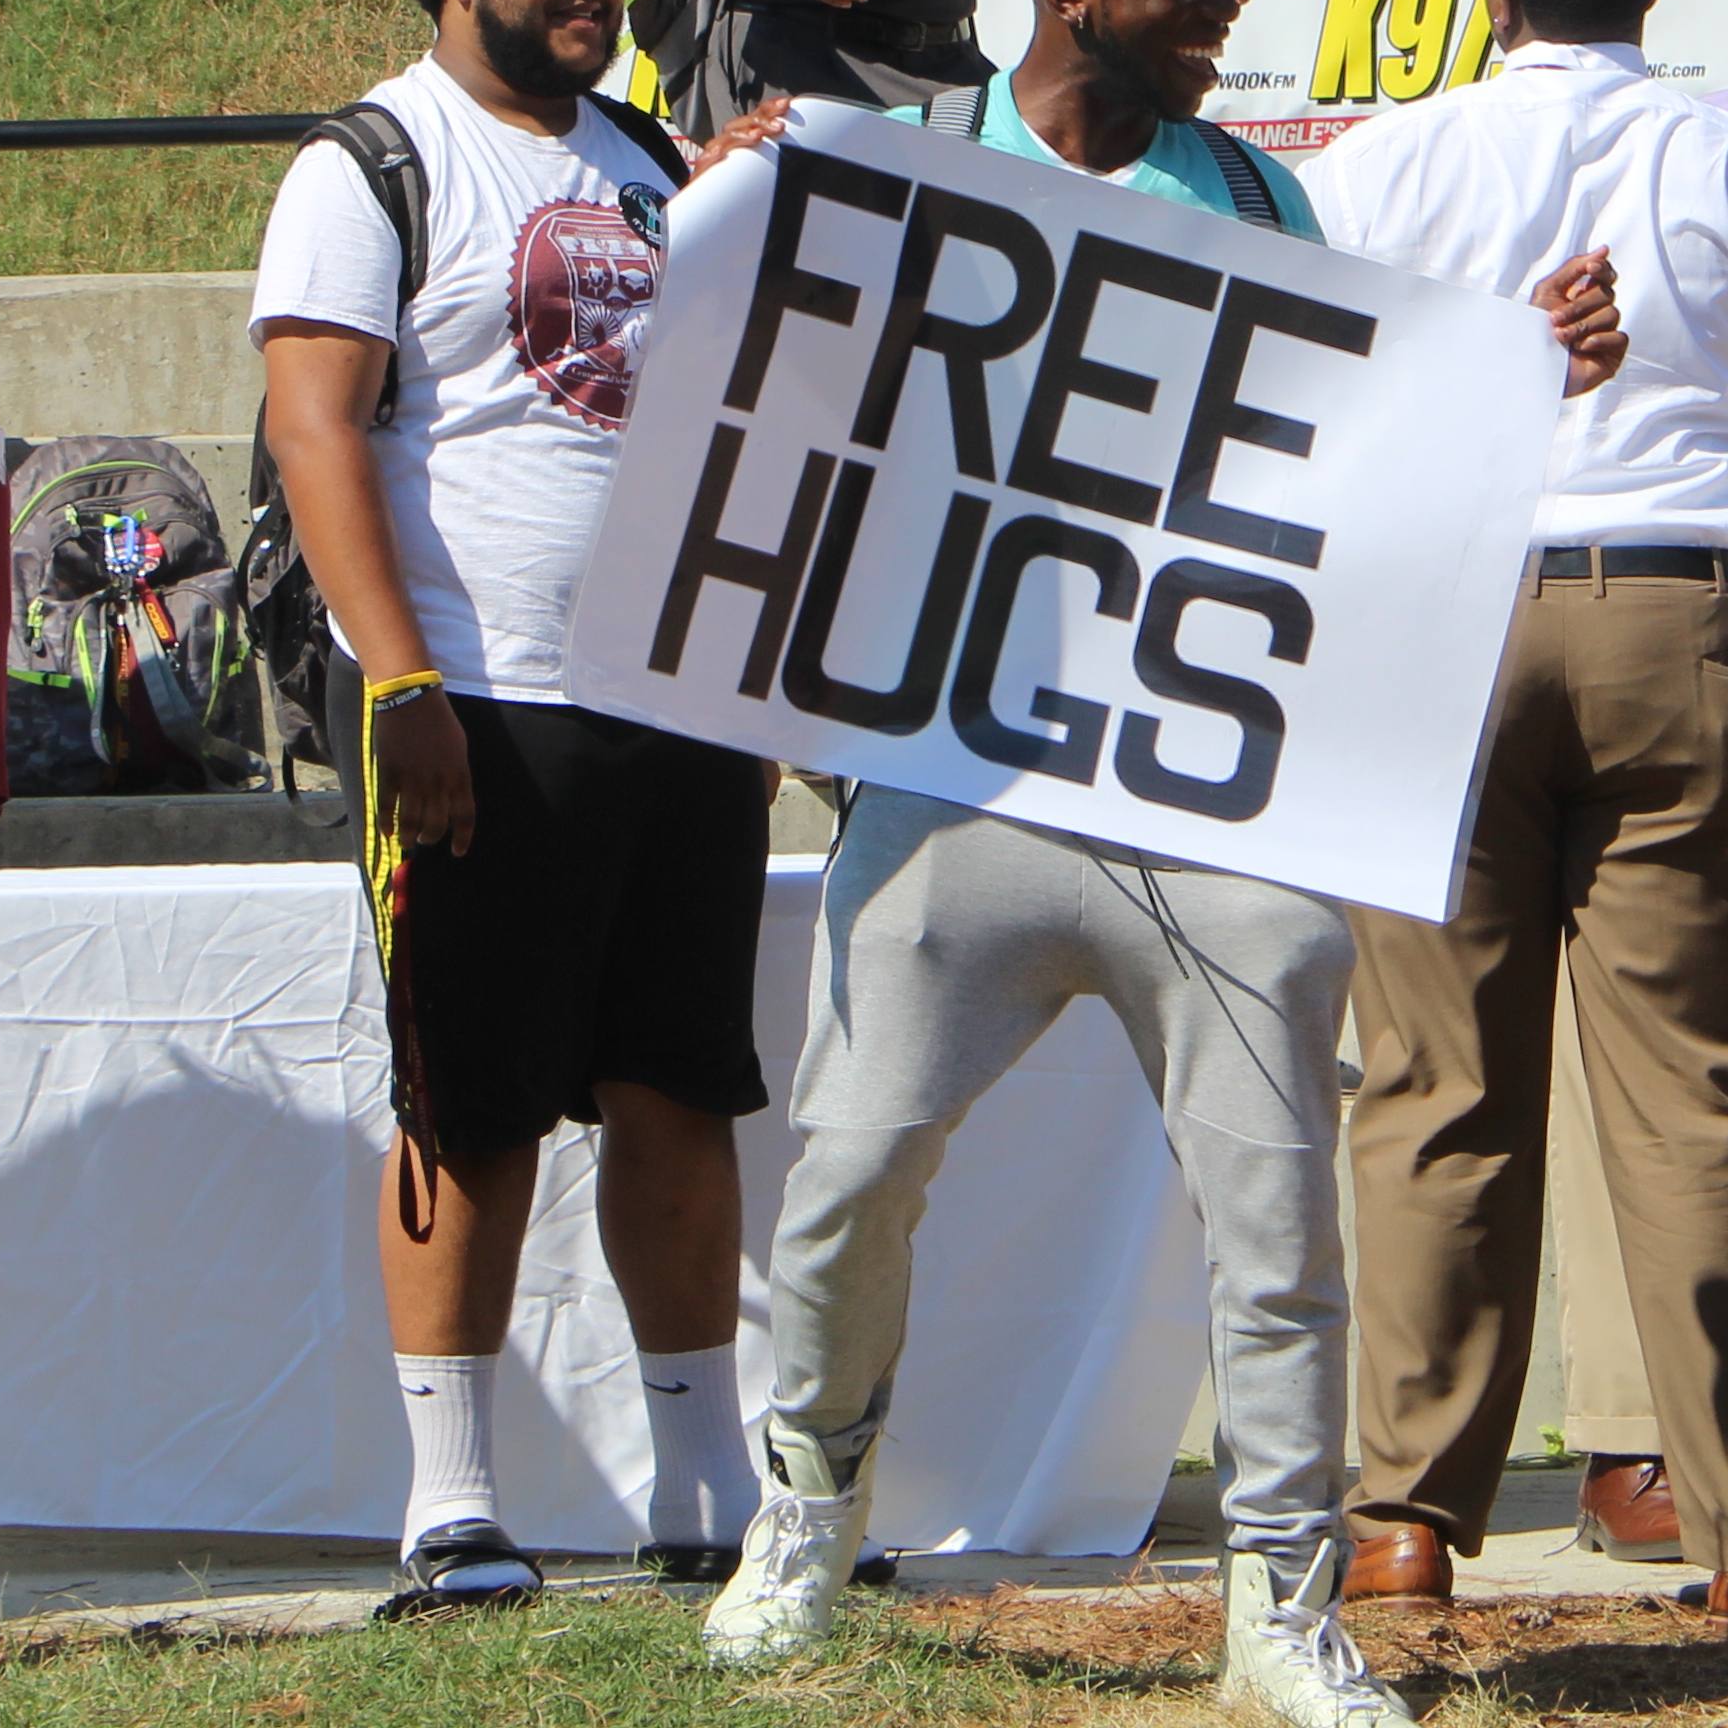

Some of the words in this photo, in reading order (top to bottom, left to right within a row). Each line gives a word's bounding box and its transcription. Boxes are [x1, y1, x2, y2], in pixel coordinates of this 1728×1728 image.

[1274, 73, 1296, 89] FM
[1646, 62, 1707, 79] NC.com
[721, 141, 1378, 570] FREE
[647, 421, 1314, 823] HUGS
